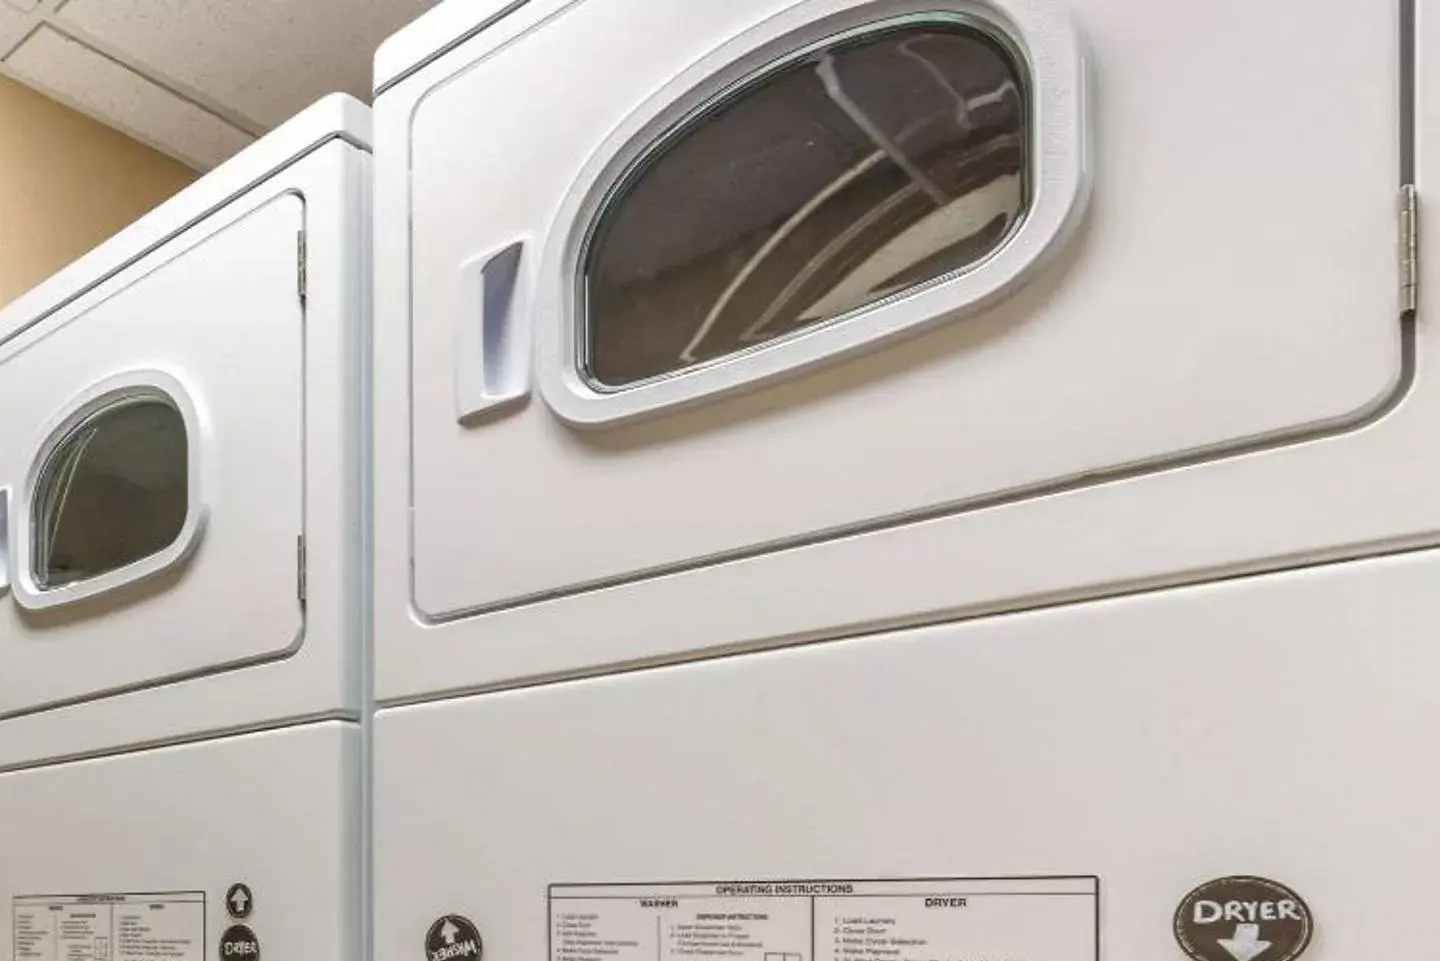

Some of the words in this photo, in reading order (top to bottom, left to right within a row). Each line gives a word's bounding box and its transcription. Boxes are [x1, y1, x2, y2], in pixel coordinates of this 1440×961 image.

[775, 884, 854, 894] INSTRUCTIONS
[924, 898, 967, 908] DRYER
[1193, 900, 1301, 924] DRYER
